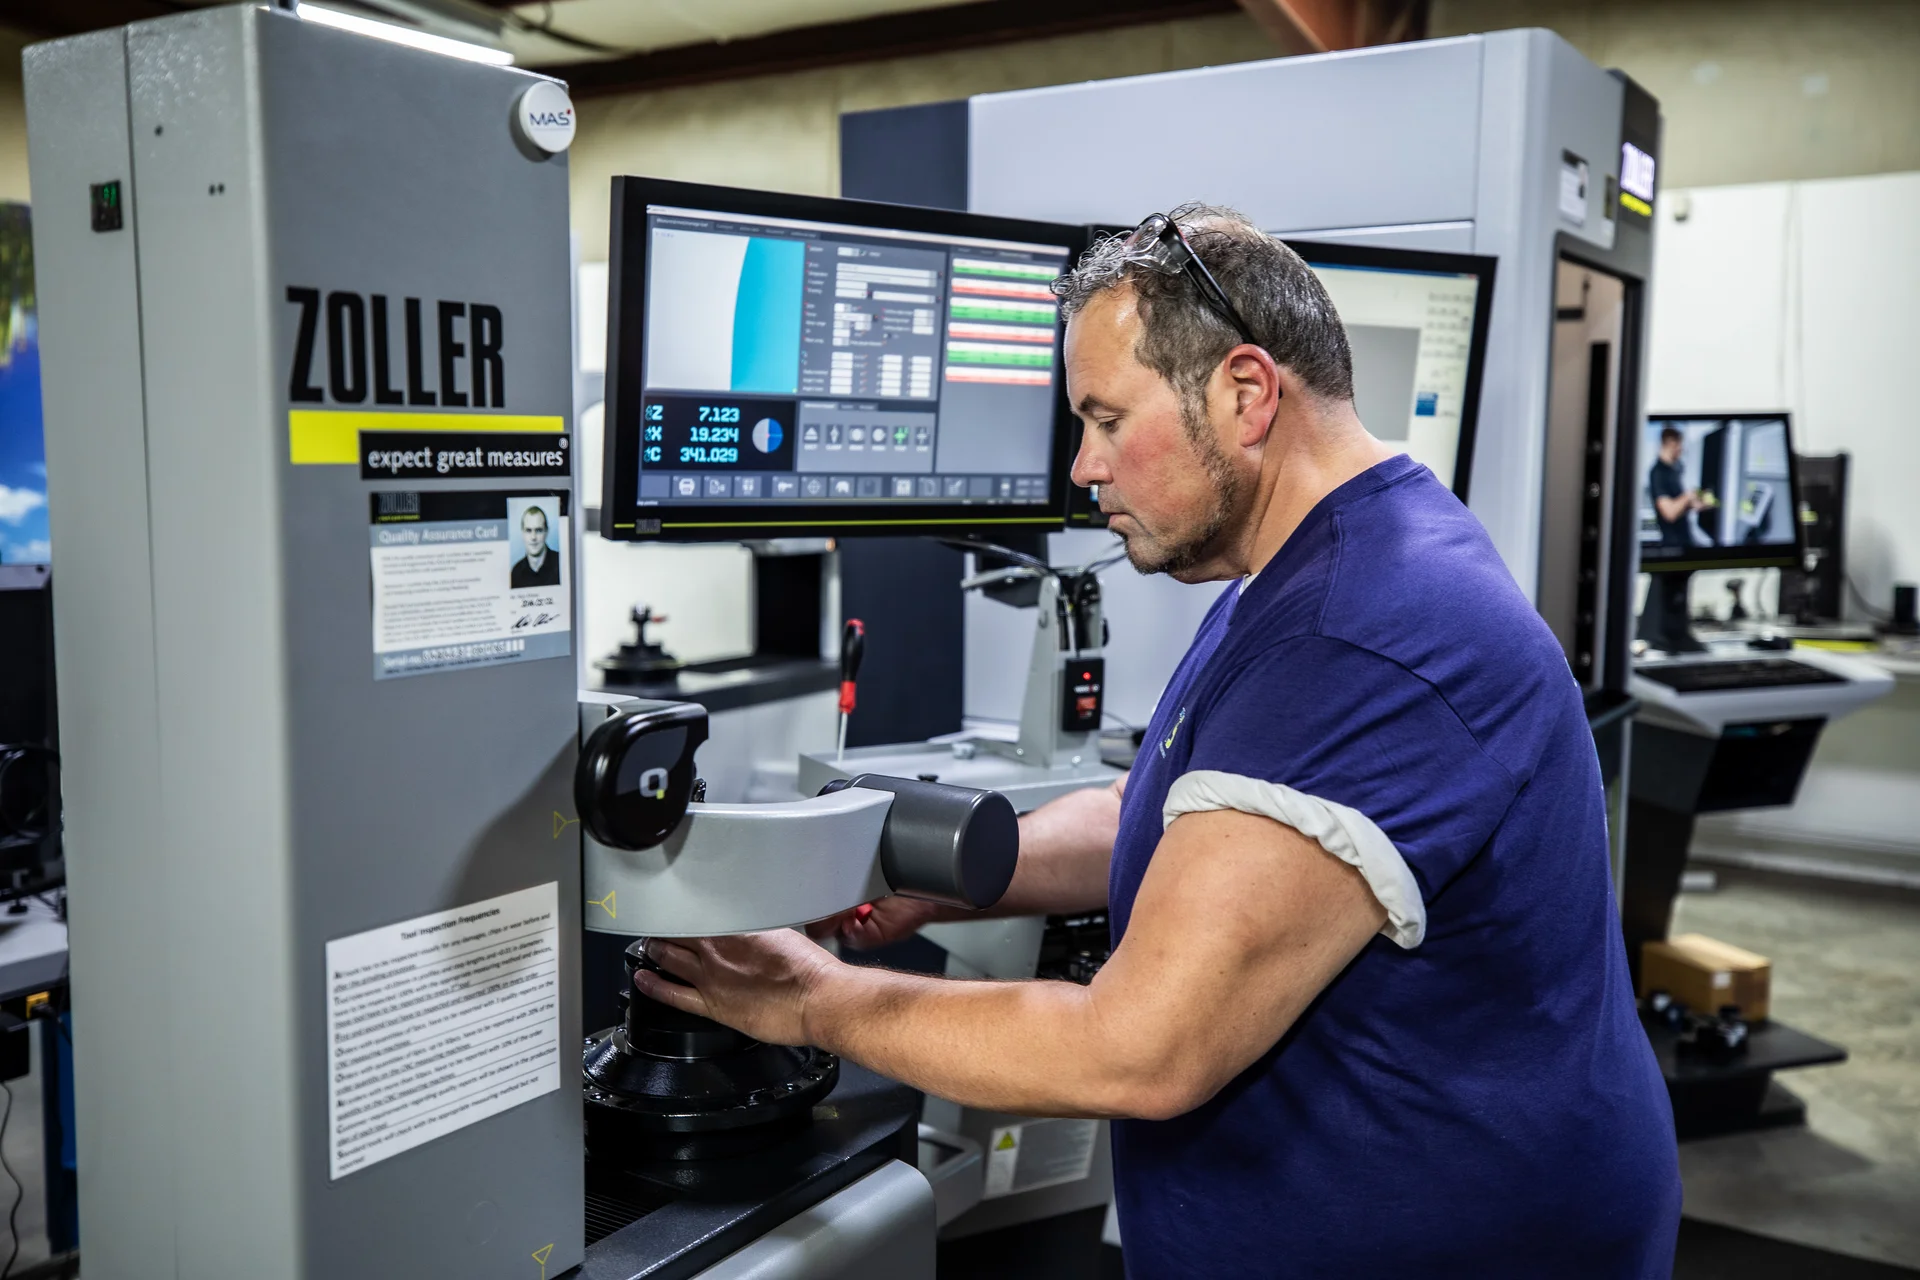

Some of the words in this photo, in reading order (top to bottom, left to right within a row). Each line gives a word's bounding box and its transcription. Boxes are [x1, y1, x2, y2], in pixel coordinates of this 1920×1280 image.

[529, 112, 570, 126] MAS
[286, 286, 506, 408] ZOLLER
[699, 406, 740, 422] 7.123
[690, 426, 739, 443] 19.234
[368, 446, 433, 474] expect
[437, 447, 484, 474] great
[679, 446, 738, 463] 341.029
[378, 528, 420, 545] Quality
[422, 527, 474, 542] Assurance
[475, 525, 499, 539] Card
